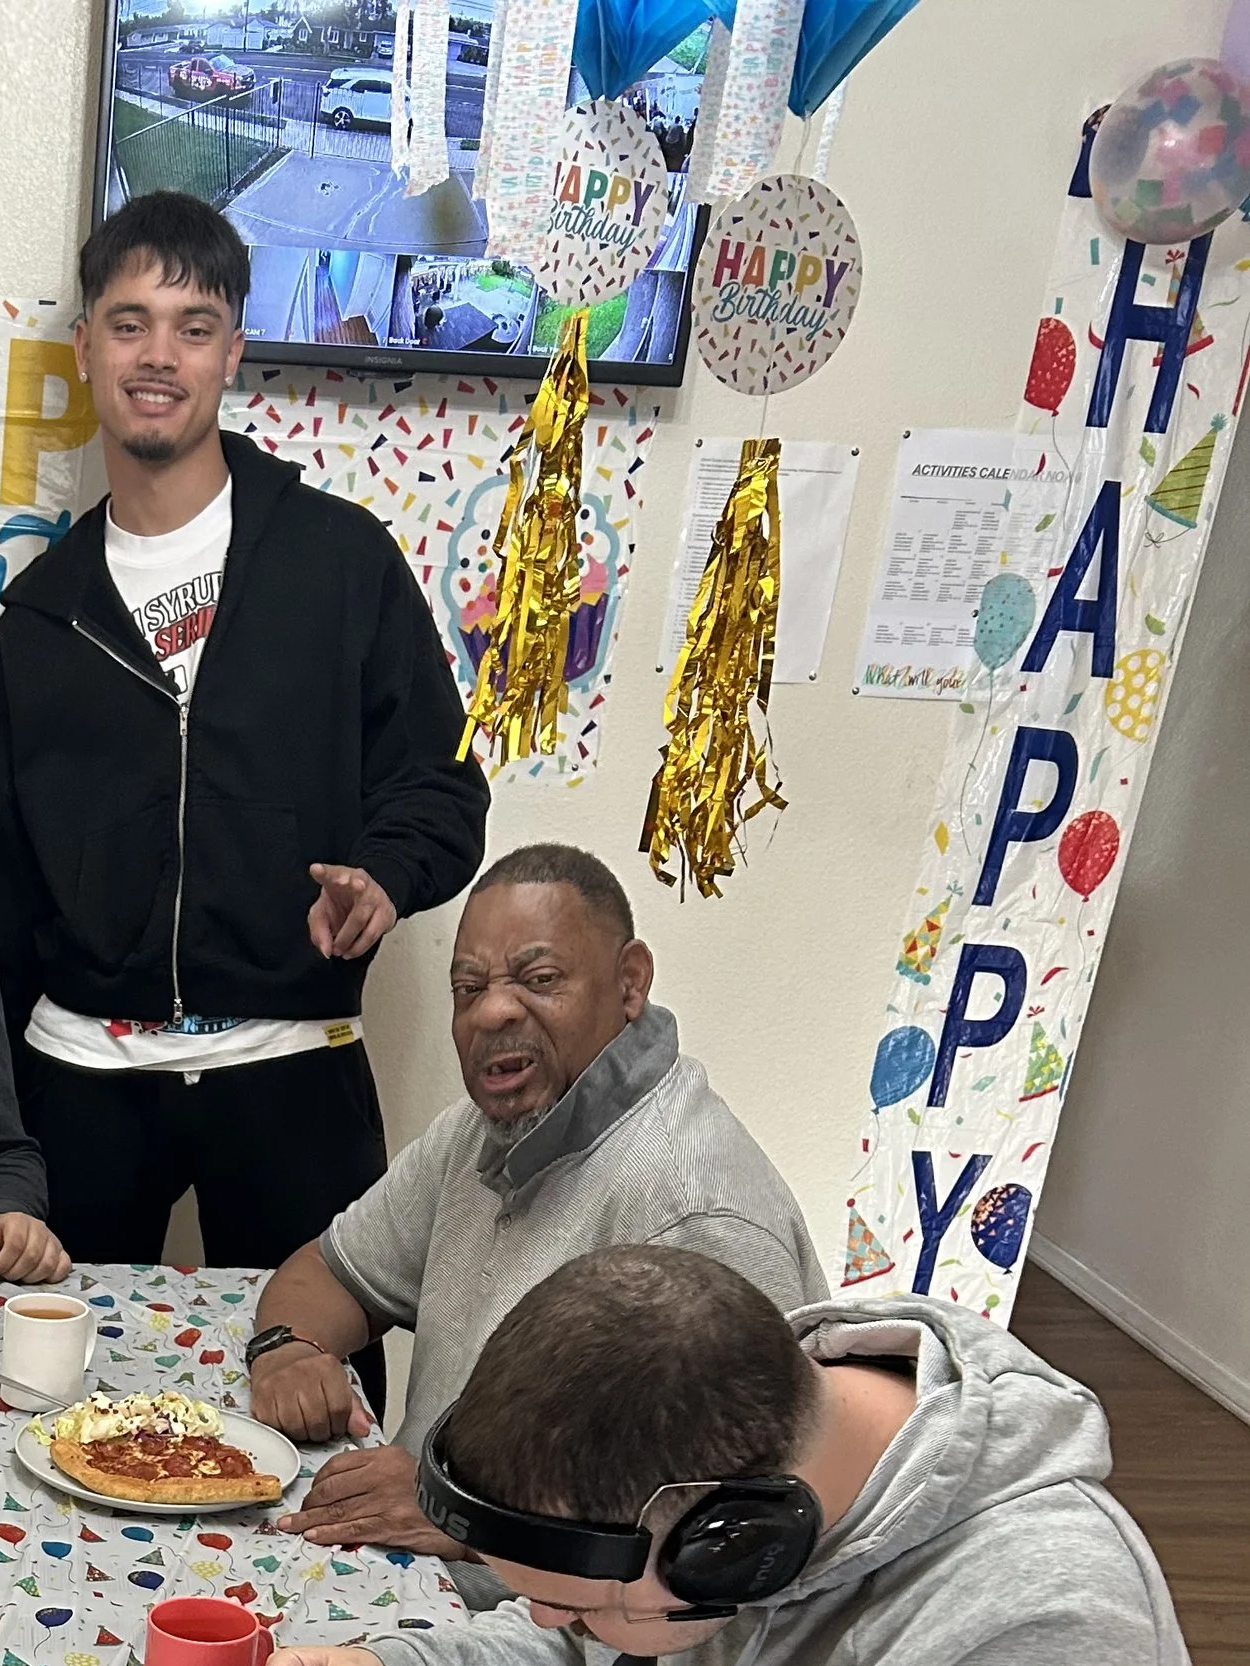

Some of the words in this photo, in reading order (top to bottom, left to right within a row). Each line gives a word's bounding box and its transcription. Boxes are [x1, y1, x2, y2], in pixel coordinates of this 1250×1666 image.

[552, 161, 655, 227] APPY
[713, 239, 850, 308] HAPPY
[713, 281, 828, 341] Birthday
[365, 356, 403, 365] INSIGNIA
[911, 463, 978, 479] ACTIVITIES
